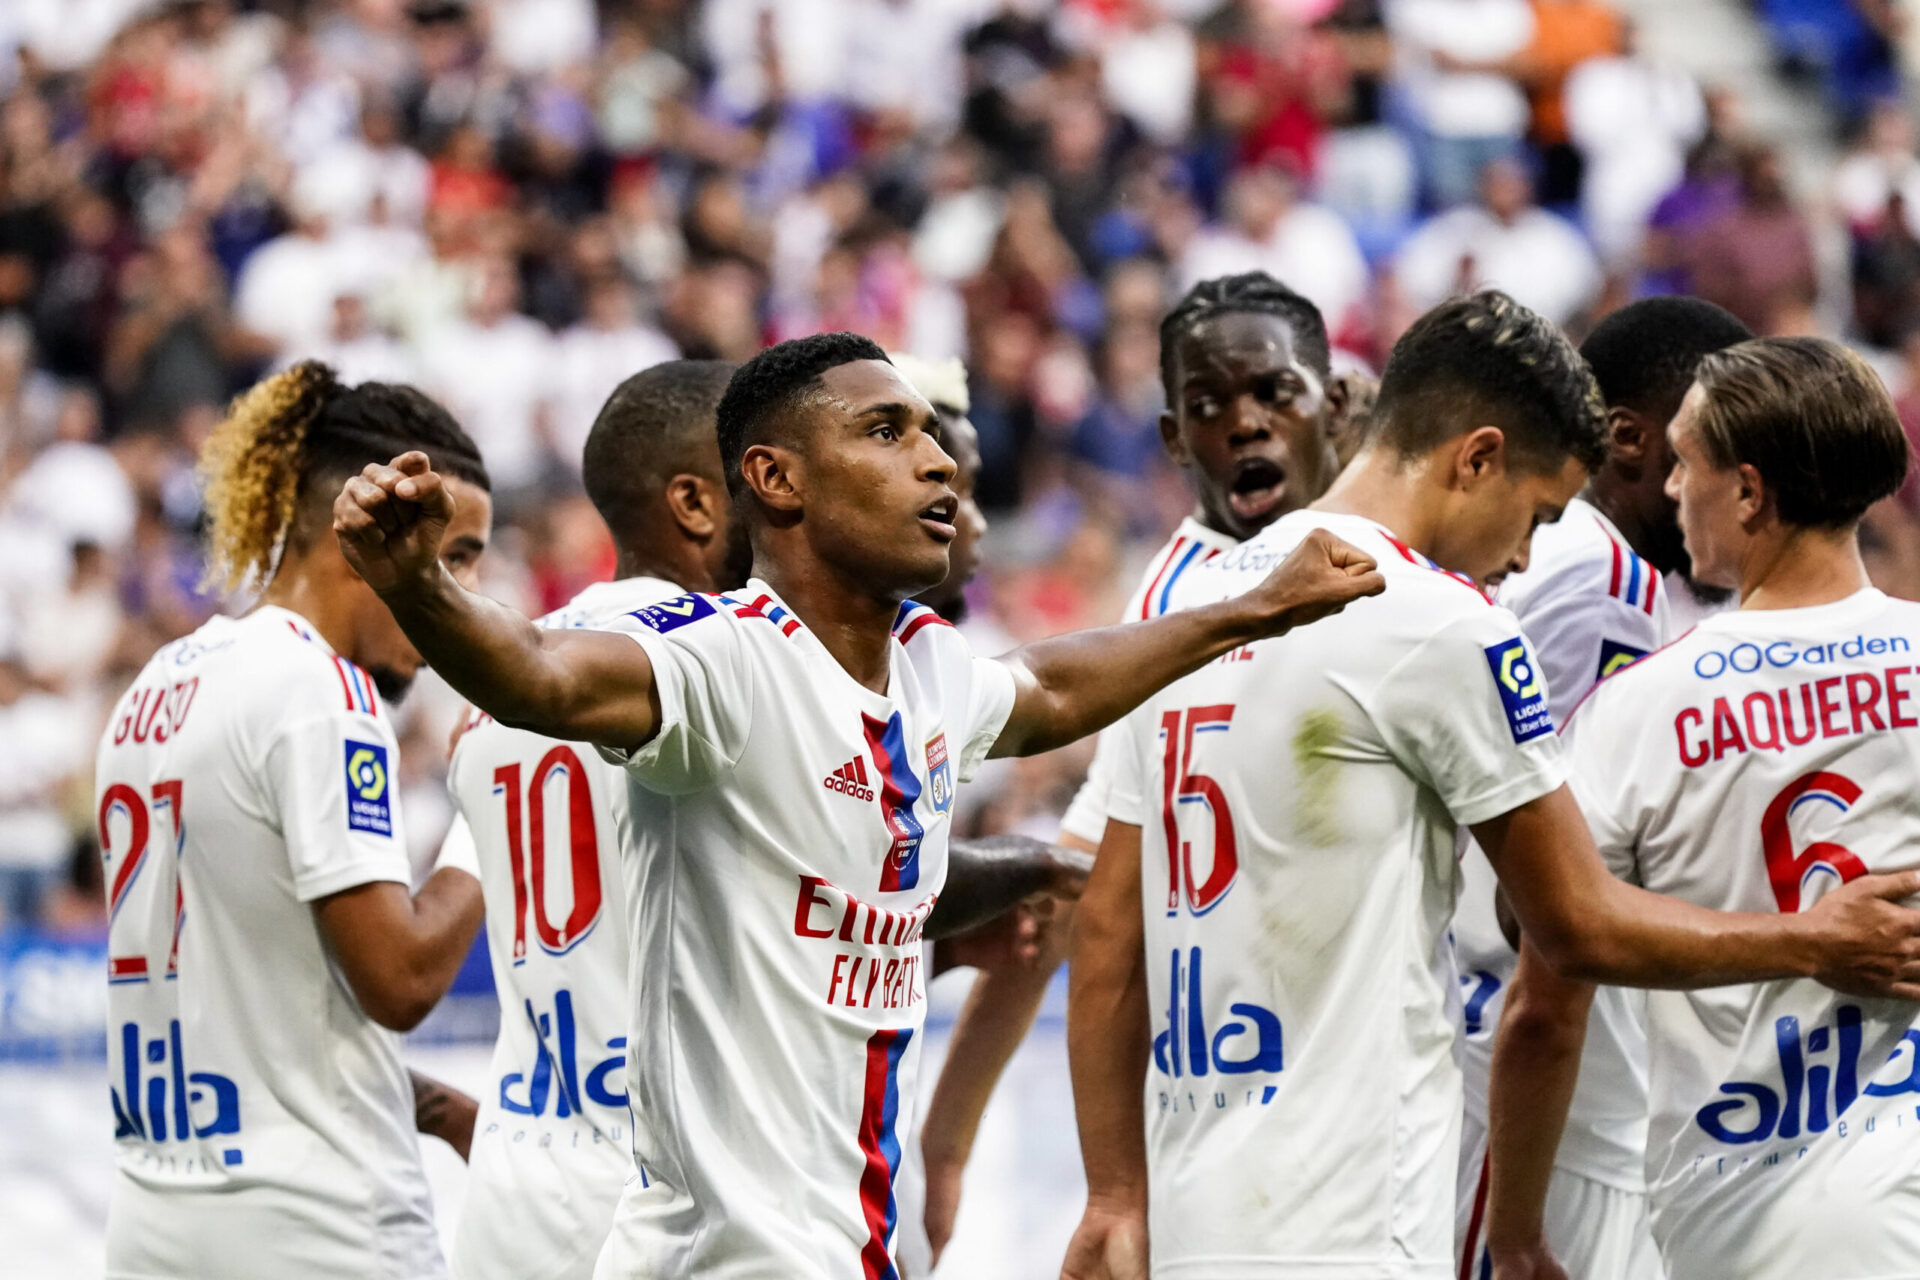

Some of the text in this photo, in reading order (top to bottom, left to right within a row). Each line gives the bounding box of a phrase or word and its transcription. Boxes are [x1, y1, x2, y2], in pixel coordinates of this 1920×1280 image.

[1675, 665, 1920, 768] CAQUERE
[1694, 634, 1910, 679] OOGarden
[824, 776, 874, 802] adidas
[1159, 704, 1238, 917] 15
[1761, 771, 1869, 914] 6
[99, 778, 186, 984] 27
[493, 745, 602, 967] 10
[827, 953, 881, 1009] FLY
[1153, 946, 1284, 1079] lla
[110, 1018, 241, 1143] lila
